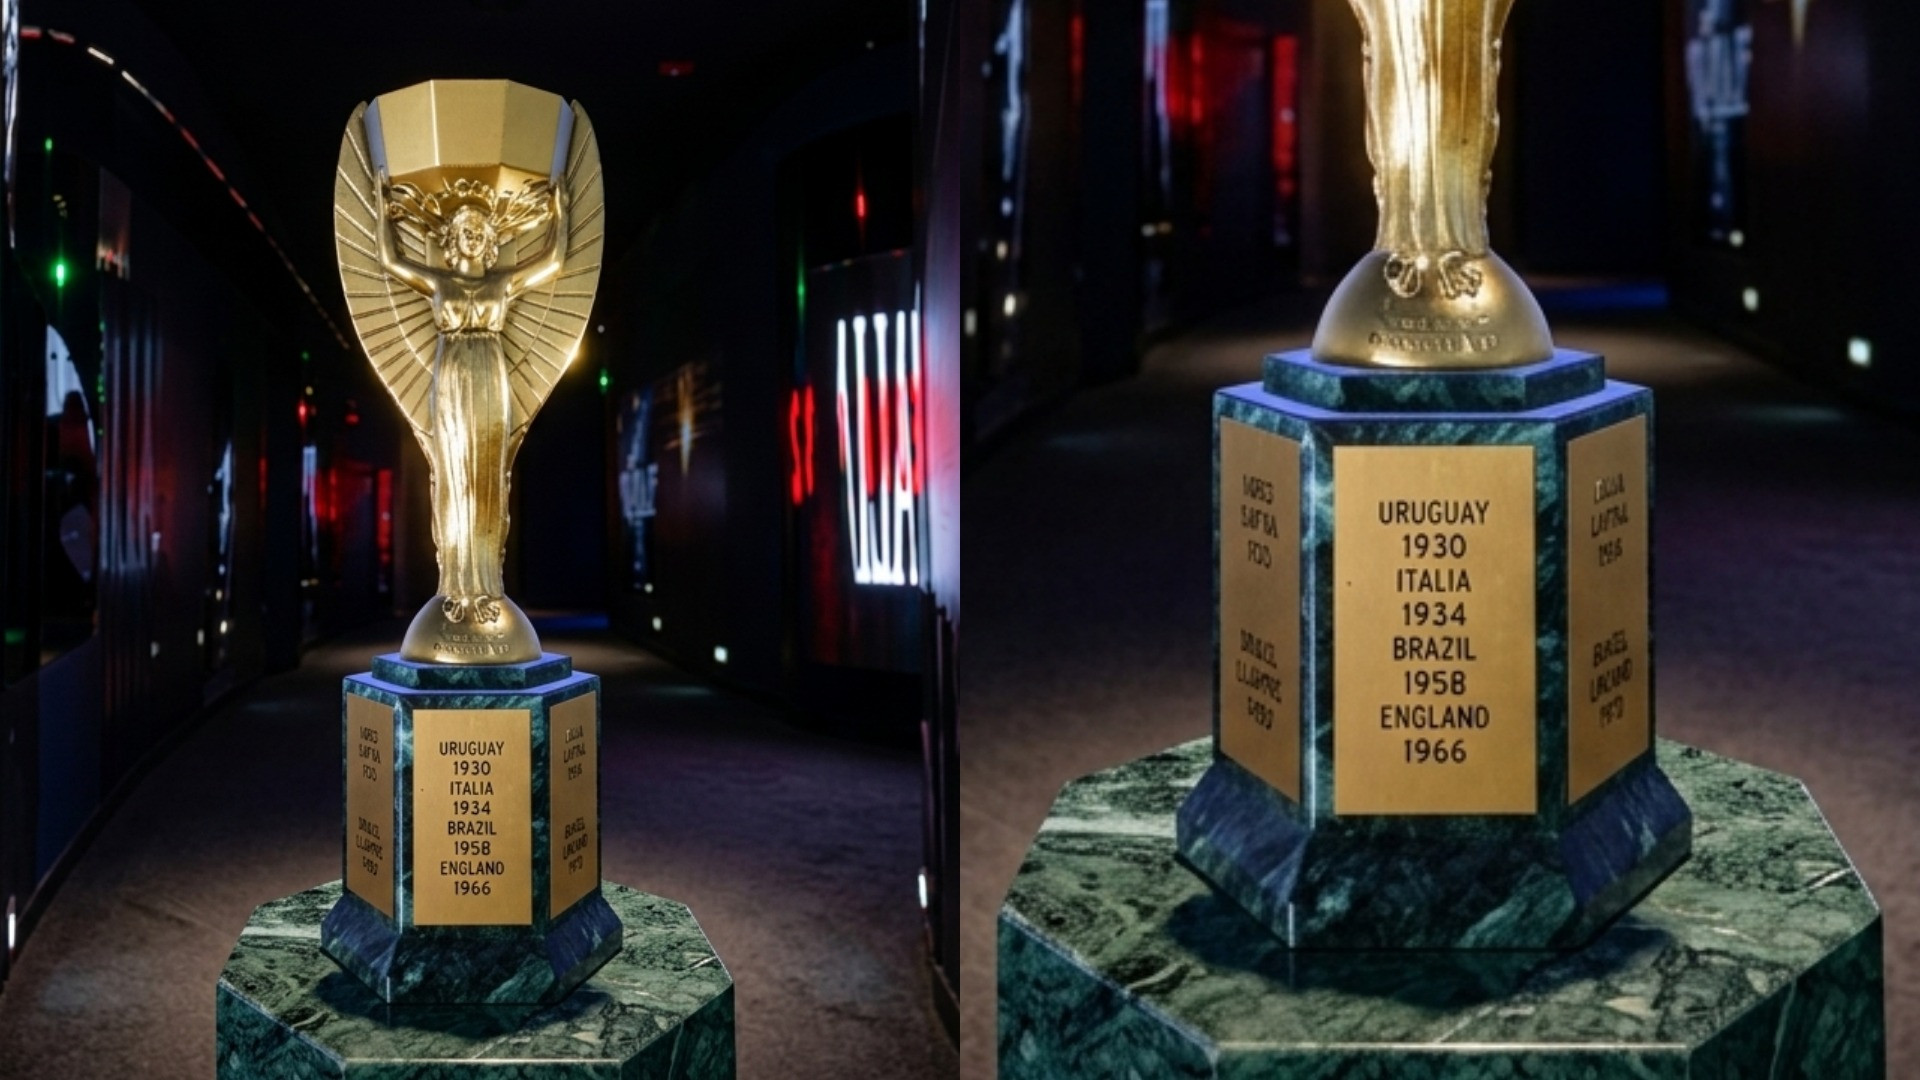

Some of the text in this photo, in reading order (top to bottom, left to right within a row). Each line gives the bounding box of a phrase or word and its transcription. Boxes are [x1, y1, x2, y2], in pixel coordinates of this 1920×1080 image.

[1379, 500, 1490, 525] URUGUAY
[1403, 532, 1467, 559] 1930
[1397, 568, 1472, 593] ITALIA
[1403, 601, 1467, 627] 1934
[1393, 635, 1477, 662] BRAZIL
[1404, 669, 1467, 696] 1958
[1380, 704, 1491, 730] ENGLAND
[439, 741, 505, 756] URUGUAY
[1404, 737, 1467, 765] 1966
[453, 760, 492, 776] 1930
[450, 781, 494, 796] ITALIA
[453, 800, 492, 816] 1934
[447, 820, 498, 836] BRAZIL
[454, 840, 492, 856] 1958
[440, 860, 505, 876] ENGLAND
[454, 879, 492, 896] 1966
